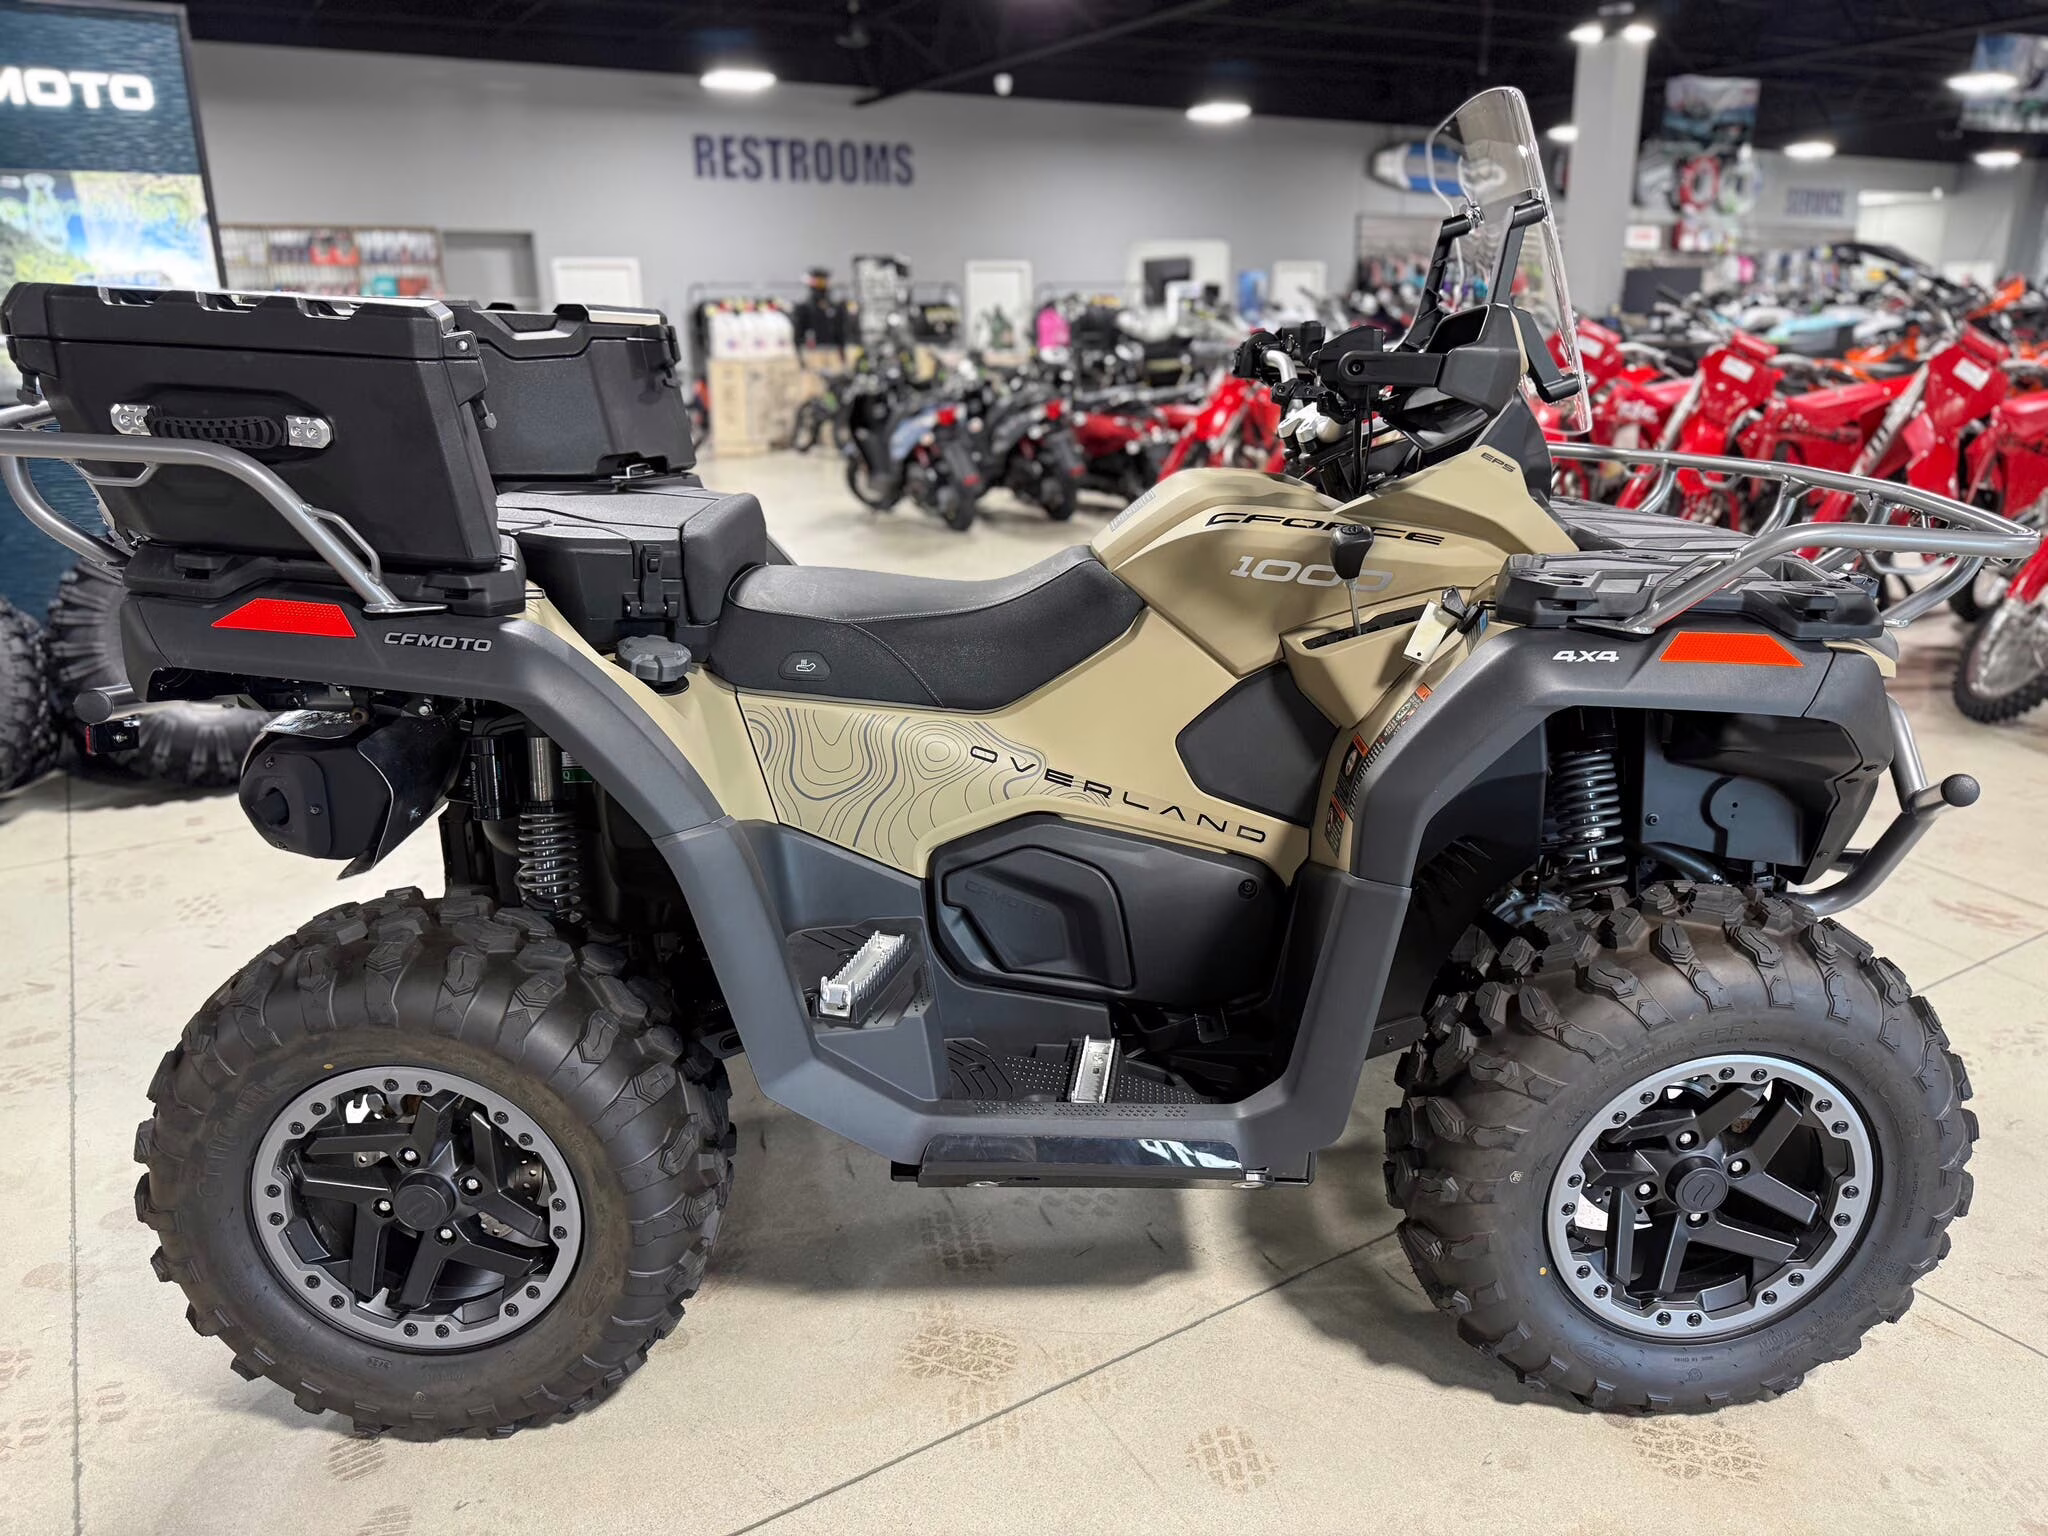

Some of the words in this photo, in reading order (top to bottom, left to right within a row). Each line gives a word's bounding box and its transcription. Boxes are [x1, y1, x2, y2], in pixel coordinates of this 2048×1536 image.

[693, 133, 915, 187] RESTROOMS
[1481, 452, 1516, 473] EPS
[383, 632, 492, 652] CFMOTO
[970, 745, 1266, 843] OVERLAND
